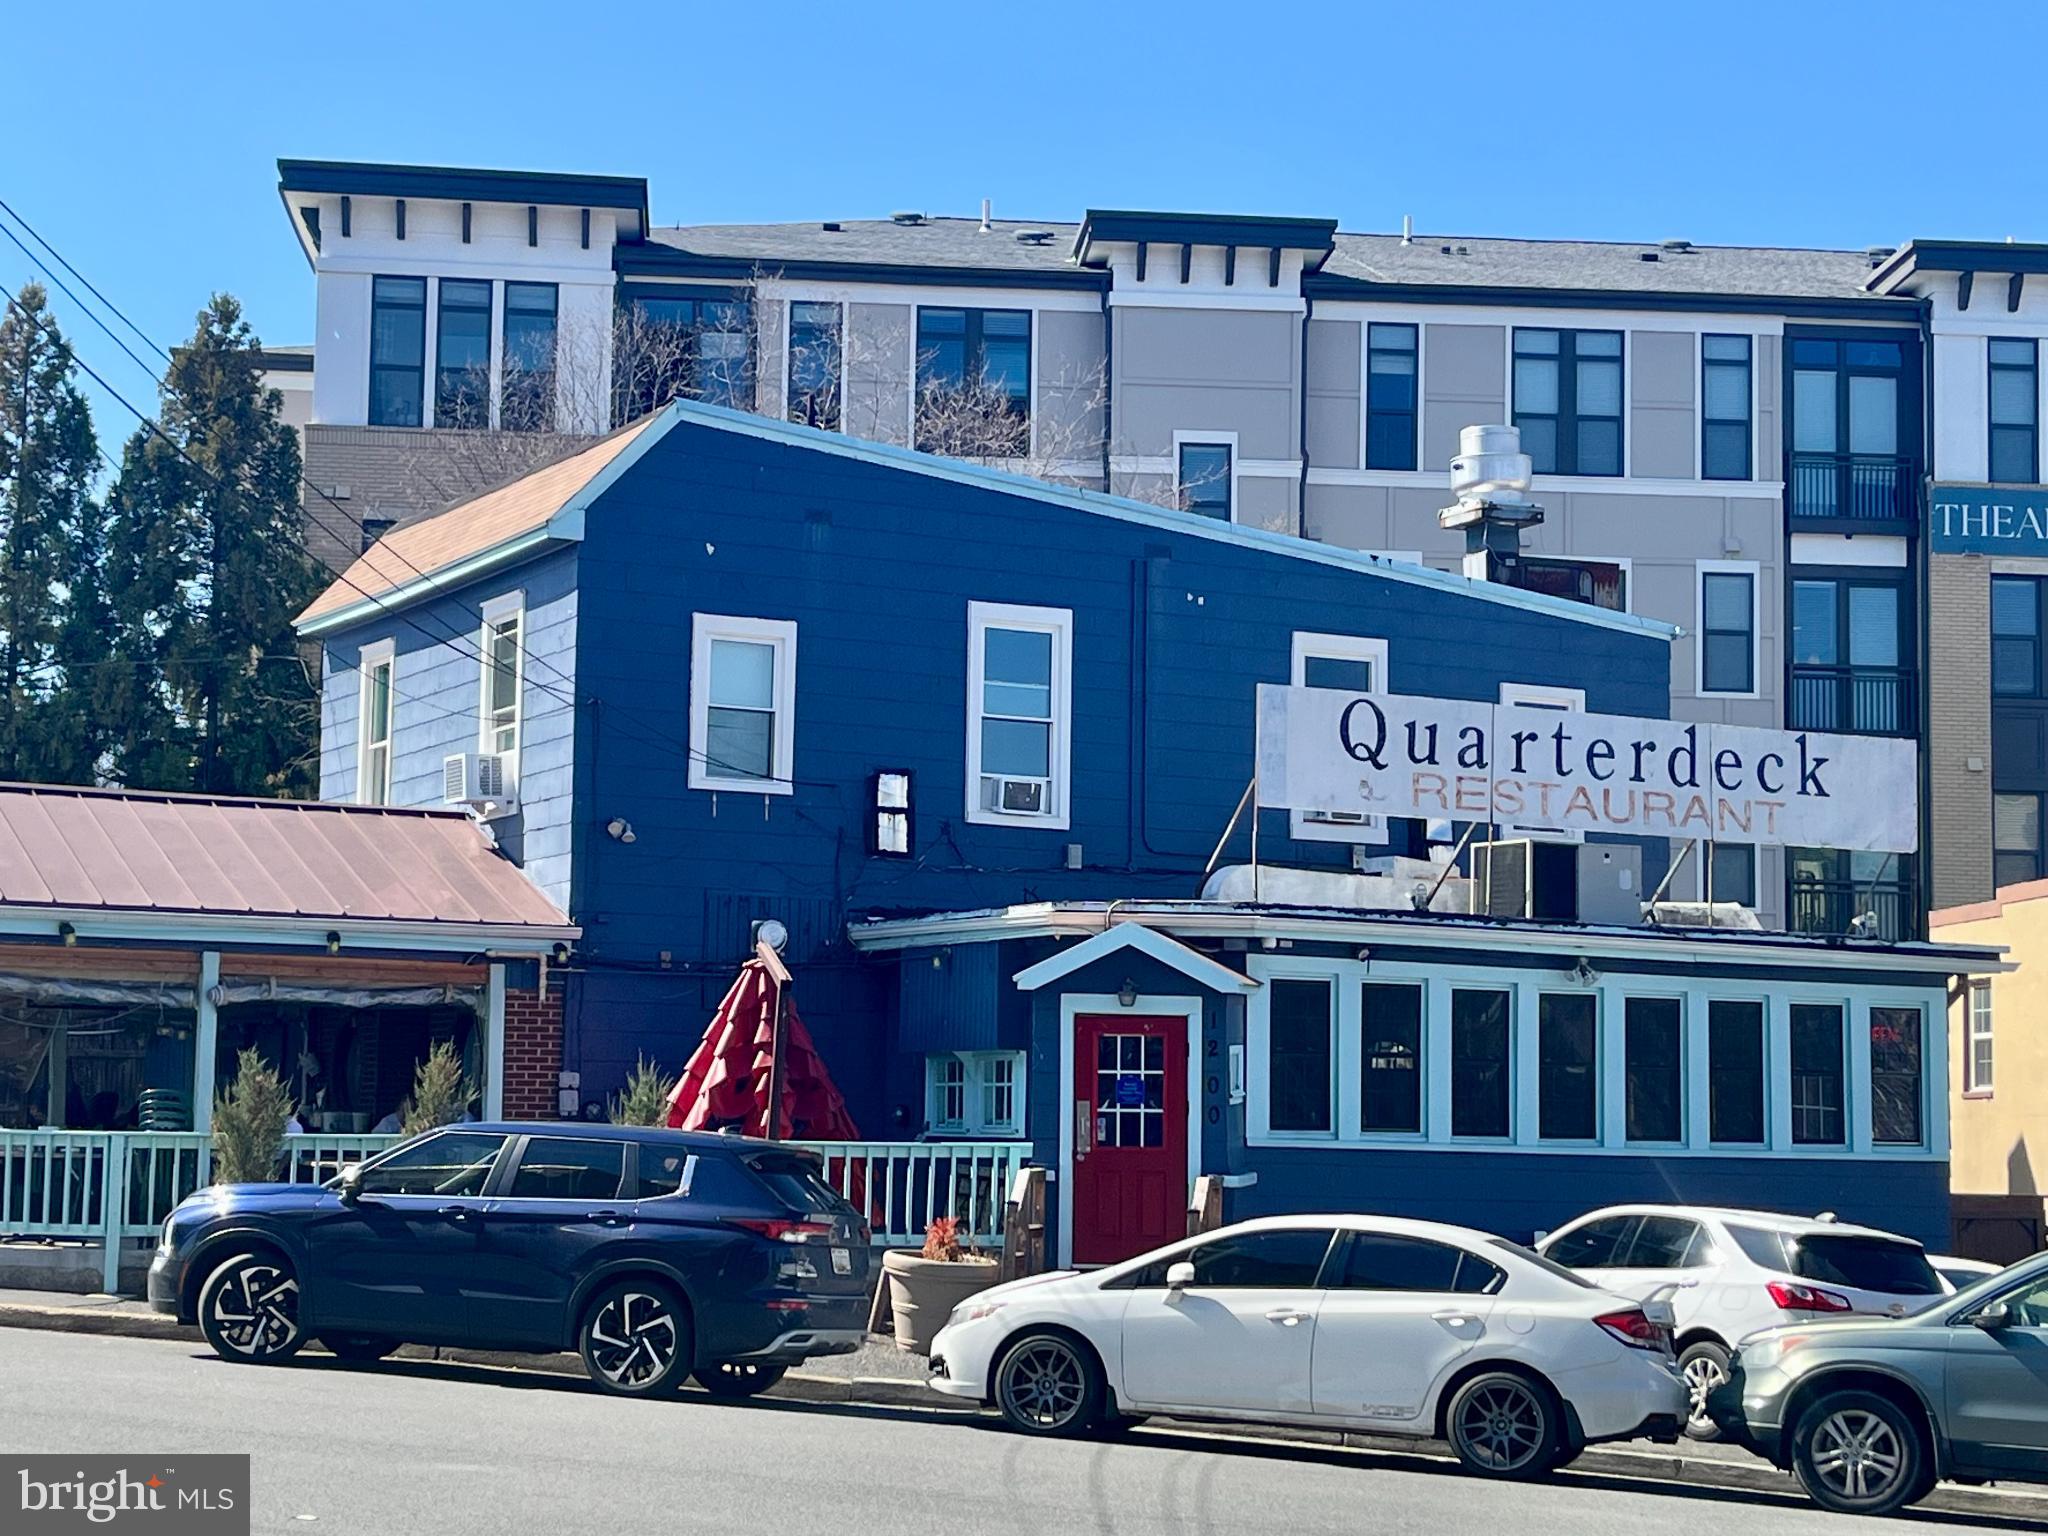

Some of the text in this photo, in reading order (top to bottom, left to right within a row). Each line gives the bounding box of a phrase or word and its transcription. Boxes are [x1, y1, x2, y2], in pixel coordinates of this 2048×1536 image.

[1935, 503, 2048, 540] THEA
[1338, 698, 1831, 798] Quarterdeck
[1411, 770, 1786, 834] RESTAURANT
